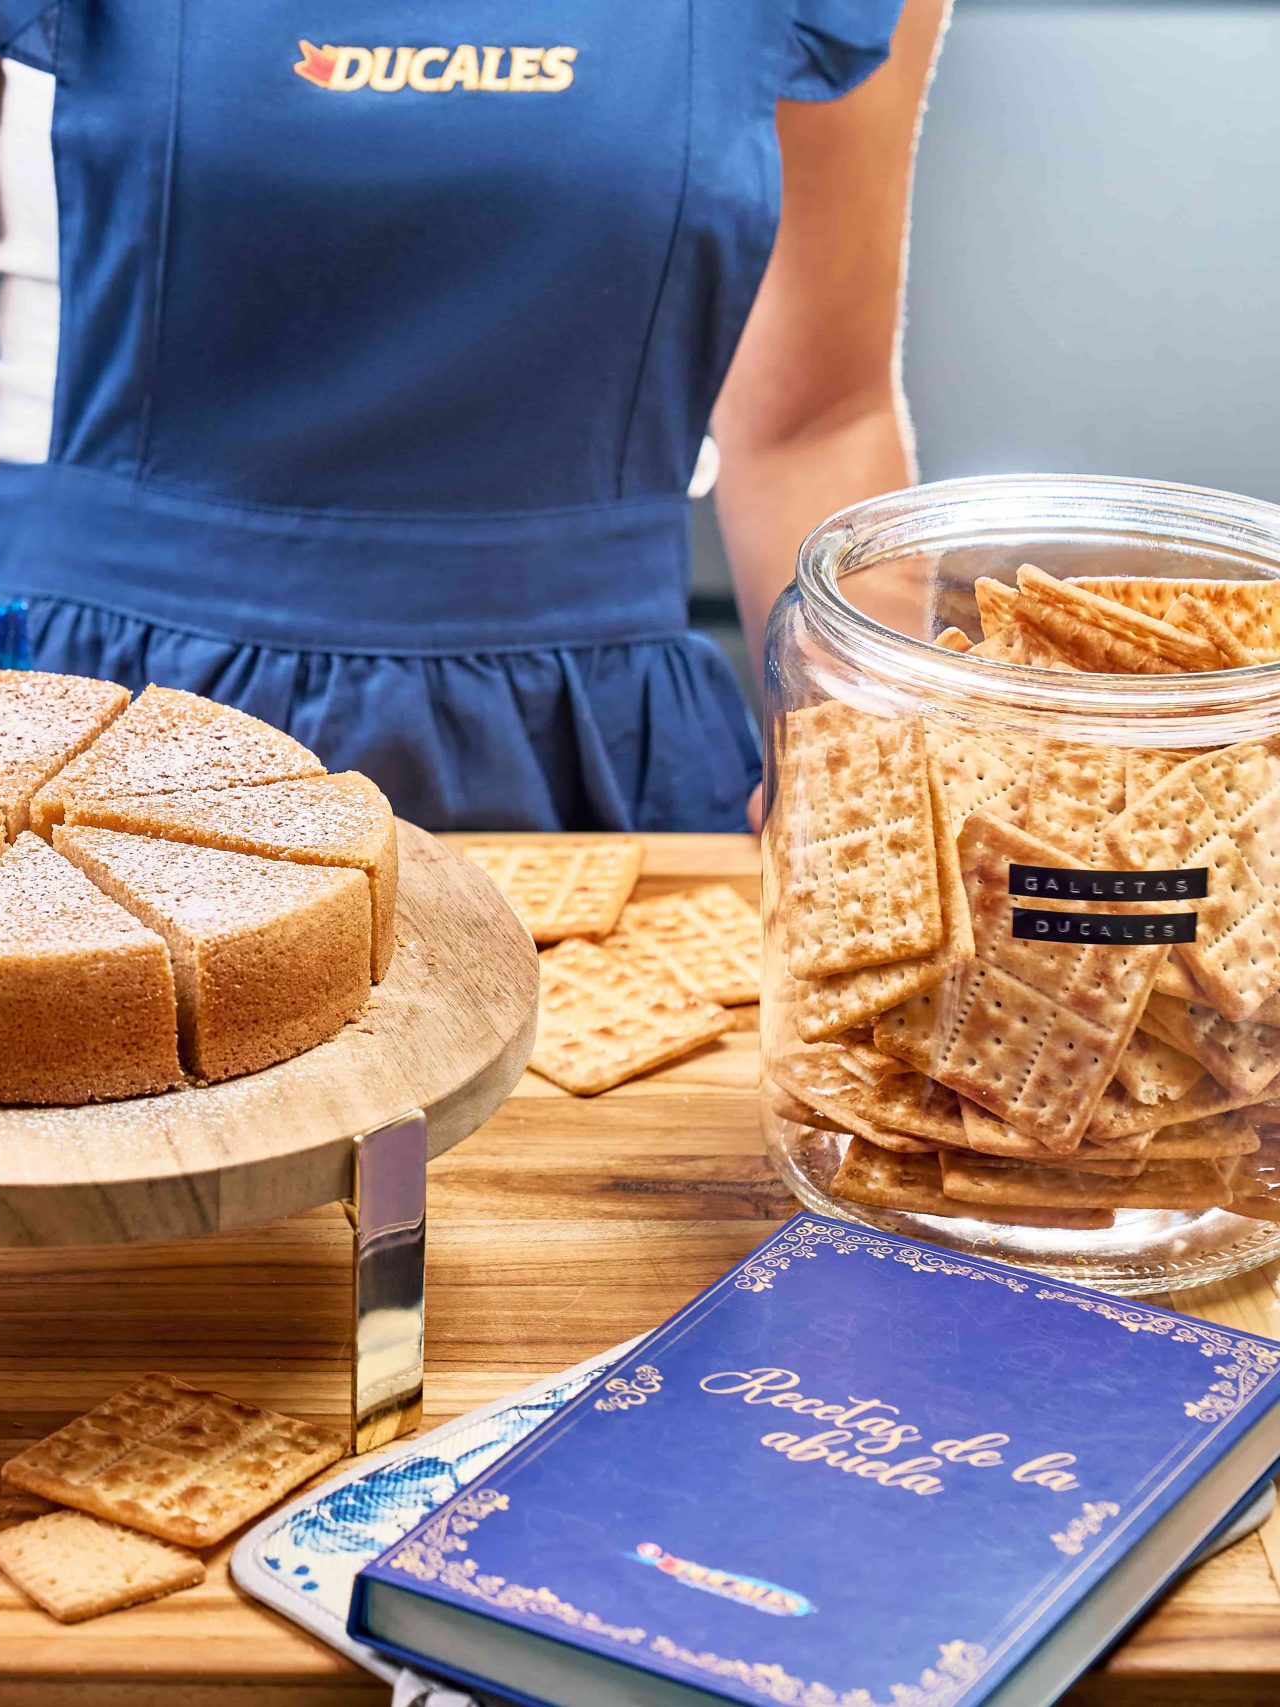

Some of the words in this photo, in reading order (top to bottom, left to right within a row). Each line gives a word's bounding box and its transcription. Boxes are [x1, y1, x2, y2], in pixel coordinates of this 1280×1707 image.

[325, 44, 579, 92] DUCALES
[1024, 876, 1189, 895] GALLETAS
[1035, 919, 1176, 938] DUCALES
[699, 1367, 923, 1455] Recetas
[930, 1432, 1011, 1468] de
[1011, 1452, 1081, 1493] la
[760, 1429, 946, 1496] abuela
